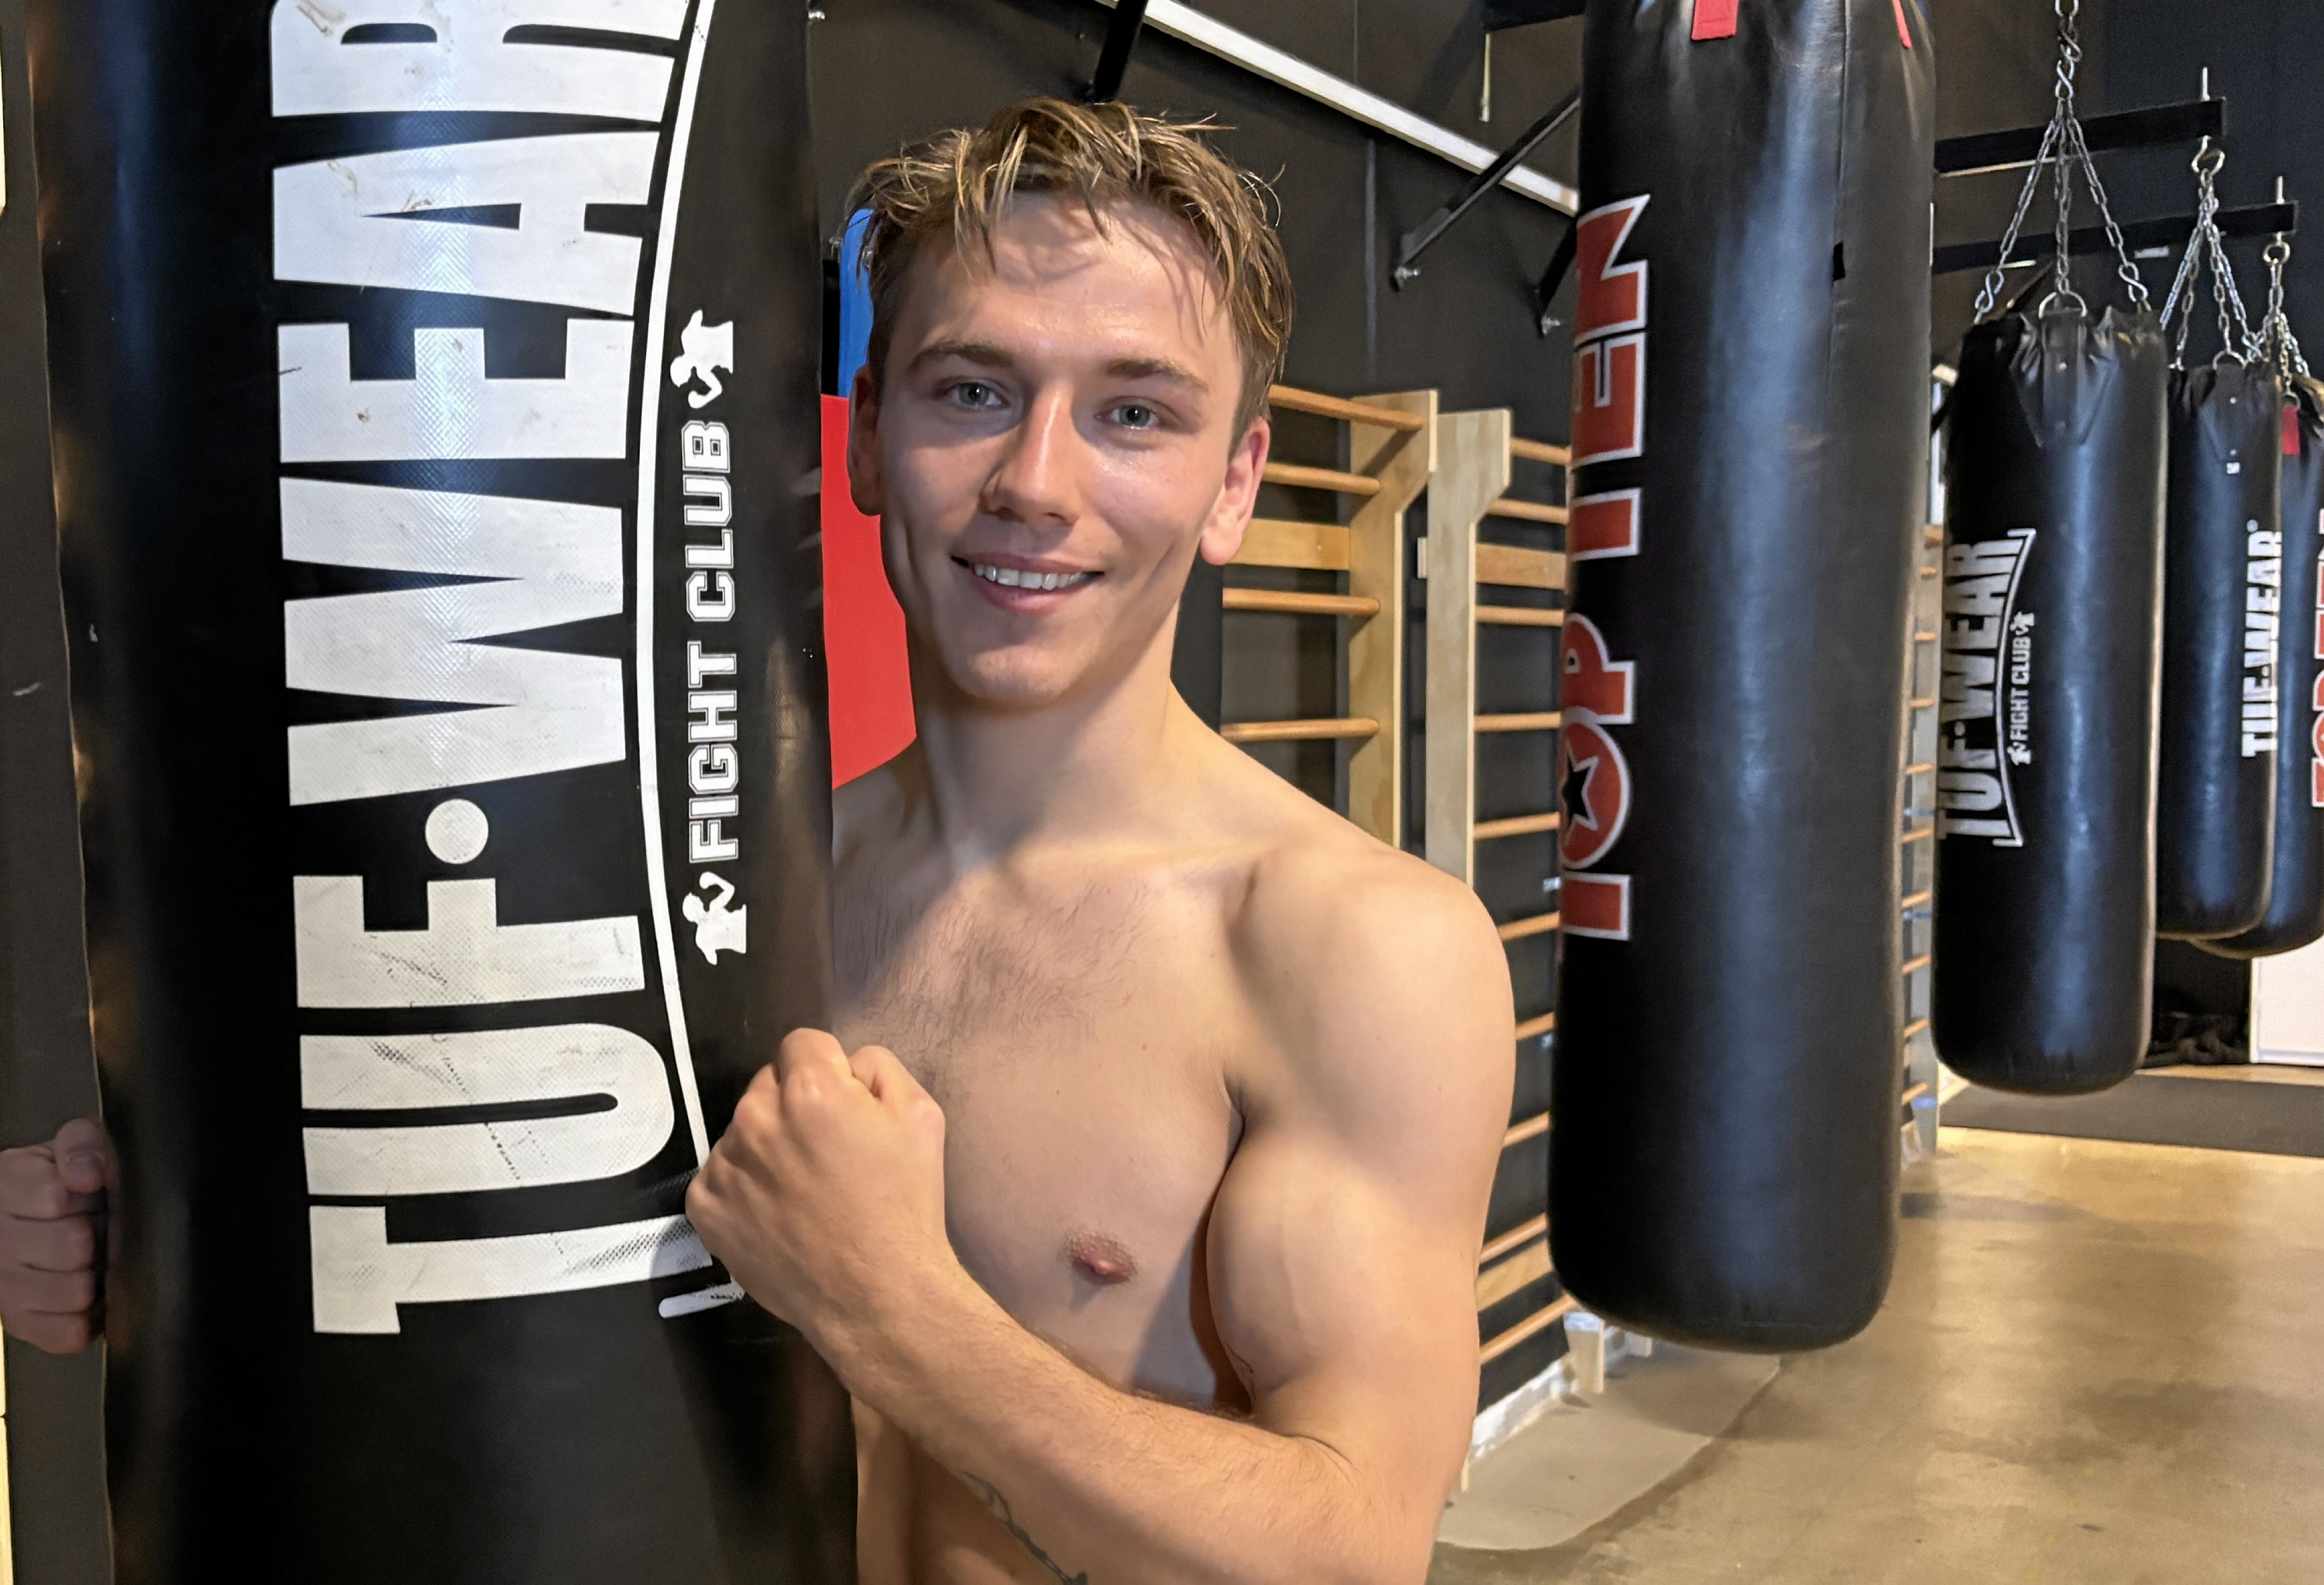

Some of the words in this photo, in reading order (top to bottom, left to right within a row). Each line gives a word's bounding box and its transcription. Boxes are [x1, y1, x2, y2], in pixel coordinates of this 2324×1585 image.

[681, 420, 735, 622] CLUB
[2009, 687, 2030, 741] FIGHT
[2011, 636, 2031, 685] CLUB
[687, 640, 740, 863] FIGHT
